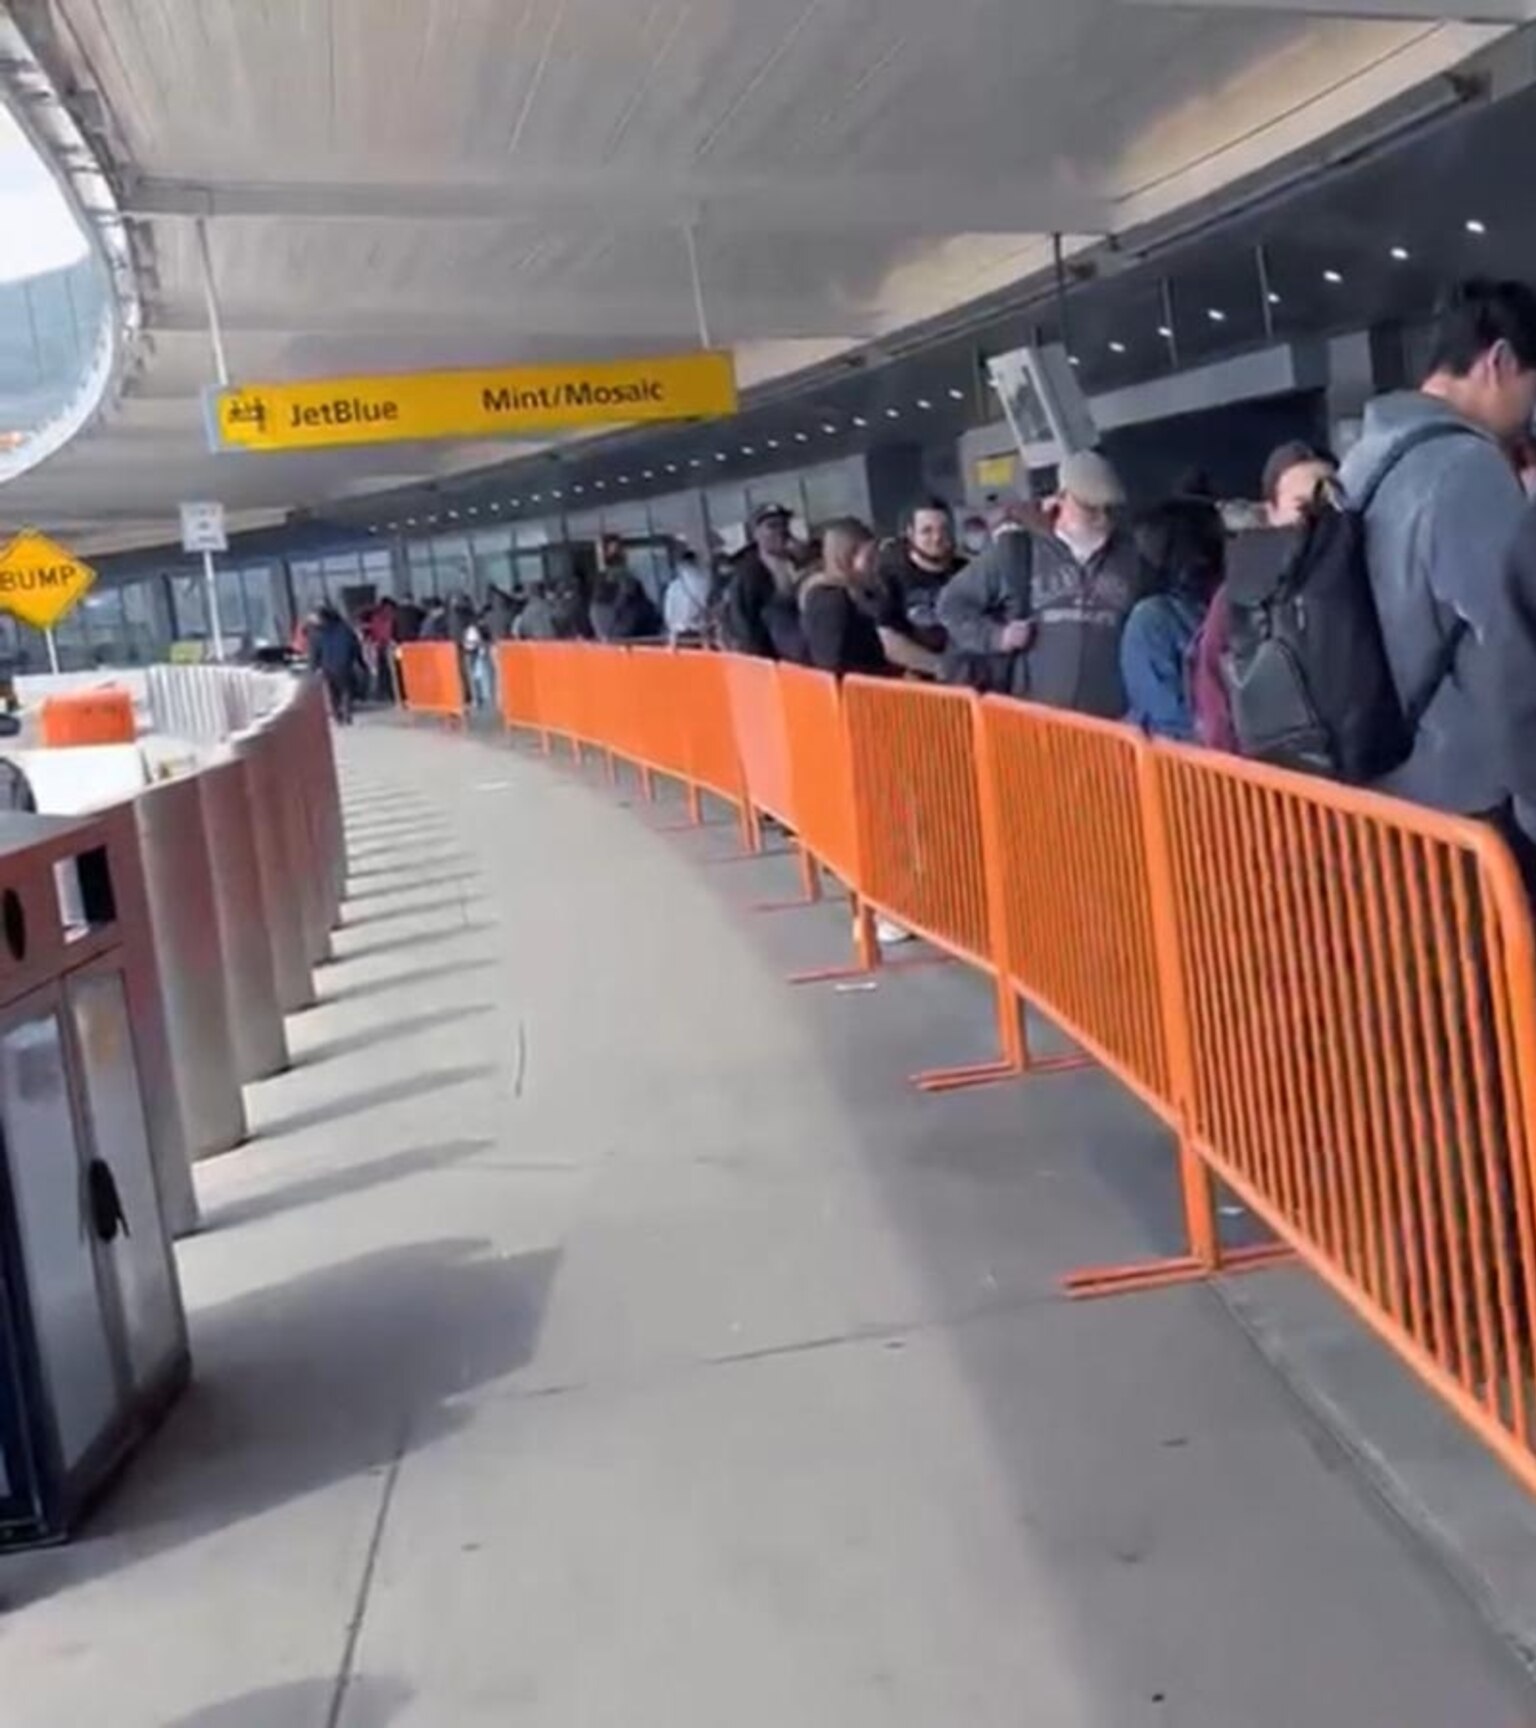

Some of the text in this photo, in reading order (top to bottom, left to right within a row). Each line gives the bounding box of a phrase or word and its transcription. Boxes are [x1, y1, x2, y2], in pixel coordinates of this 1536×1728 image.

[290, 378, 664, 428] JetBlue Mint/Mosaic
[0, 566, 77, 593] BUMP
